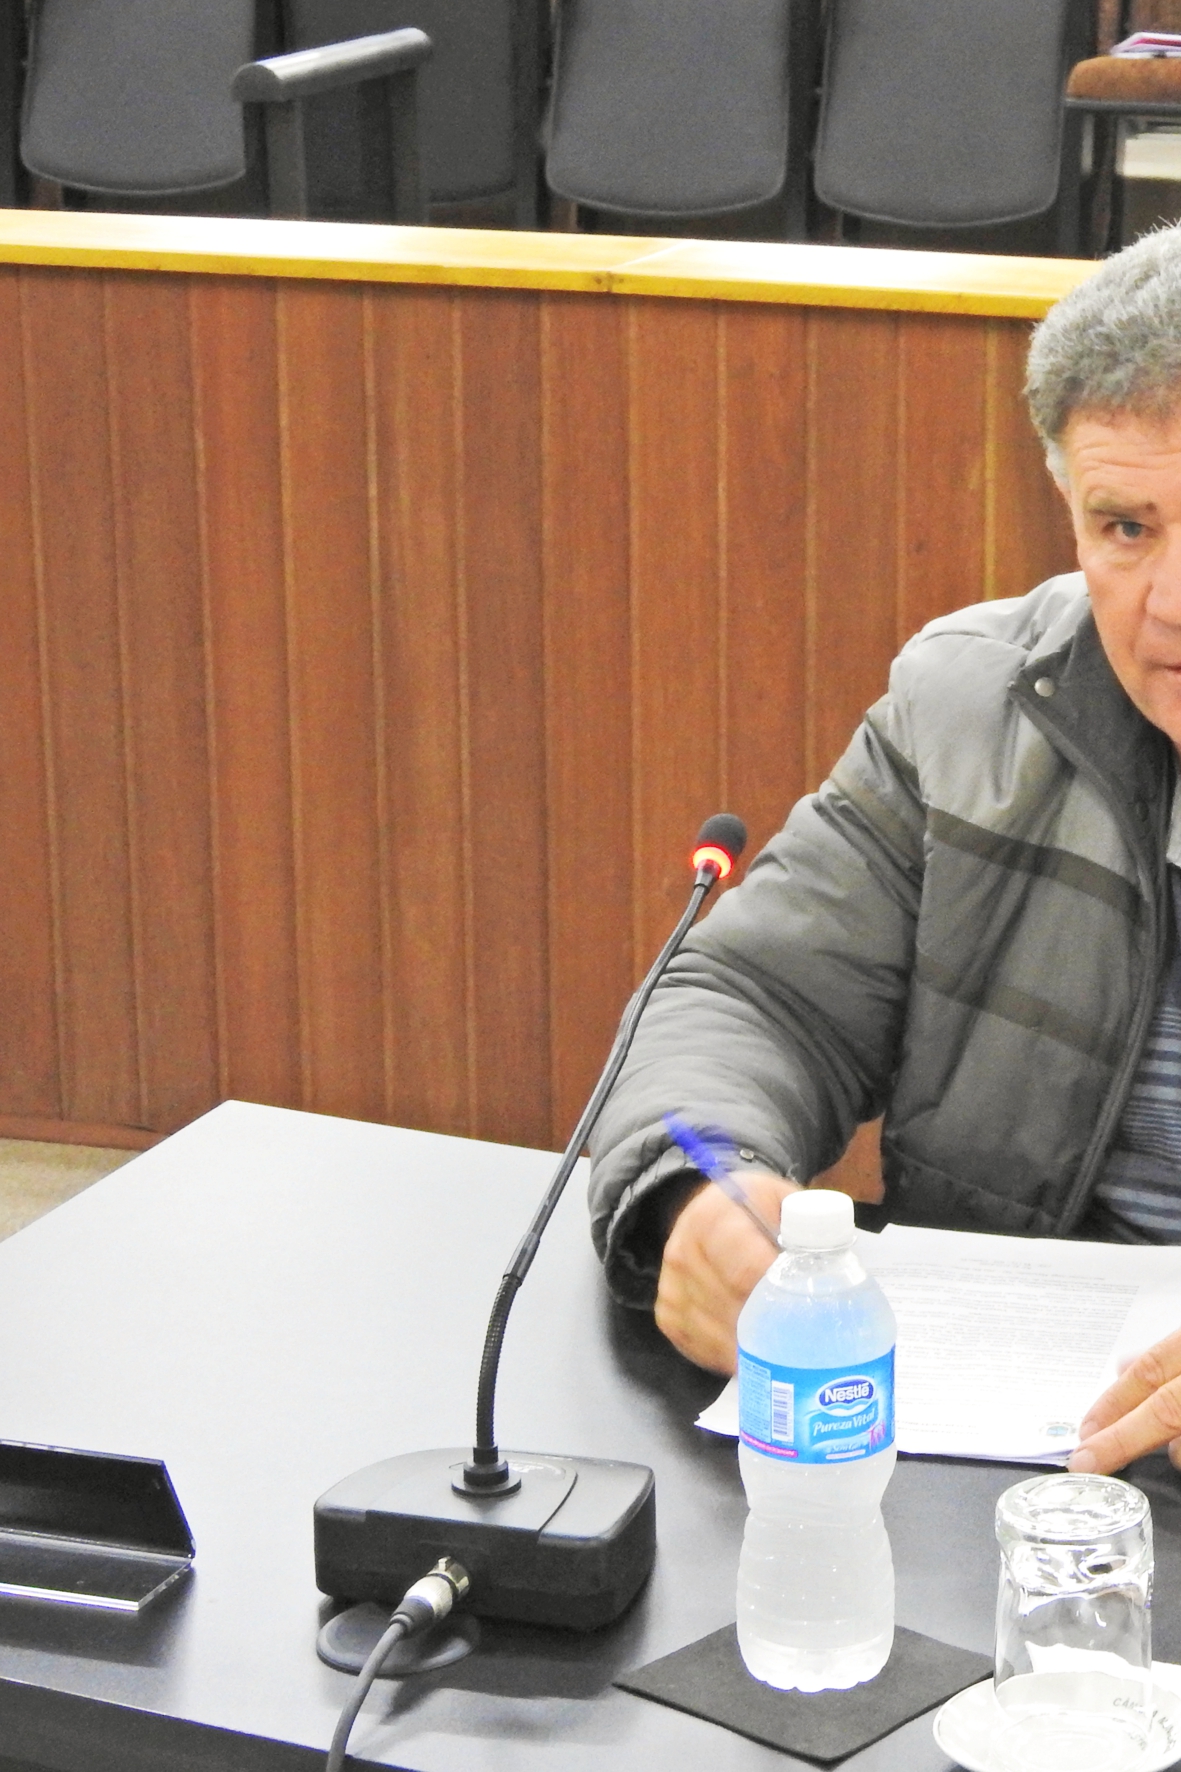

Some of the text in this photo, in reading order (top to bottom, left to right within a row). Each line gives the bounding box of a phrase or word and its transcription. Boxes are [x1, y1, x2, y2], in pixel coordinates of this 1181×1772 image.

[824, 1382, 869, 1403] Nestlé
[813, 1420, 852, 1437] Pureza
[852, 1409, 875, 1427] Vital
